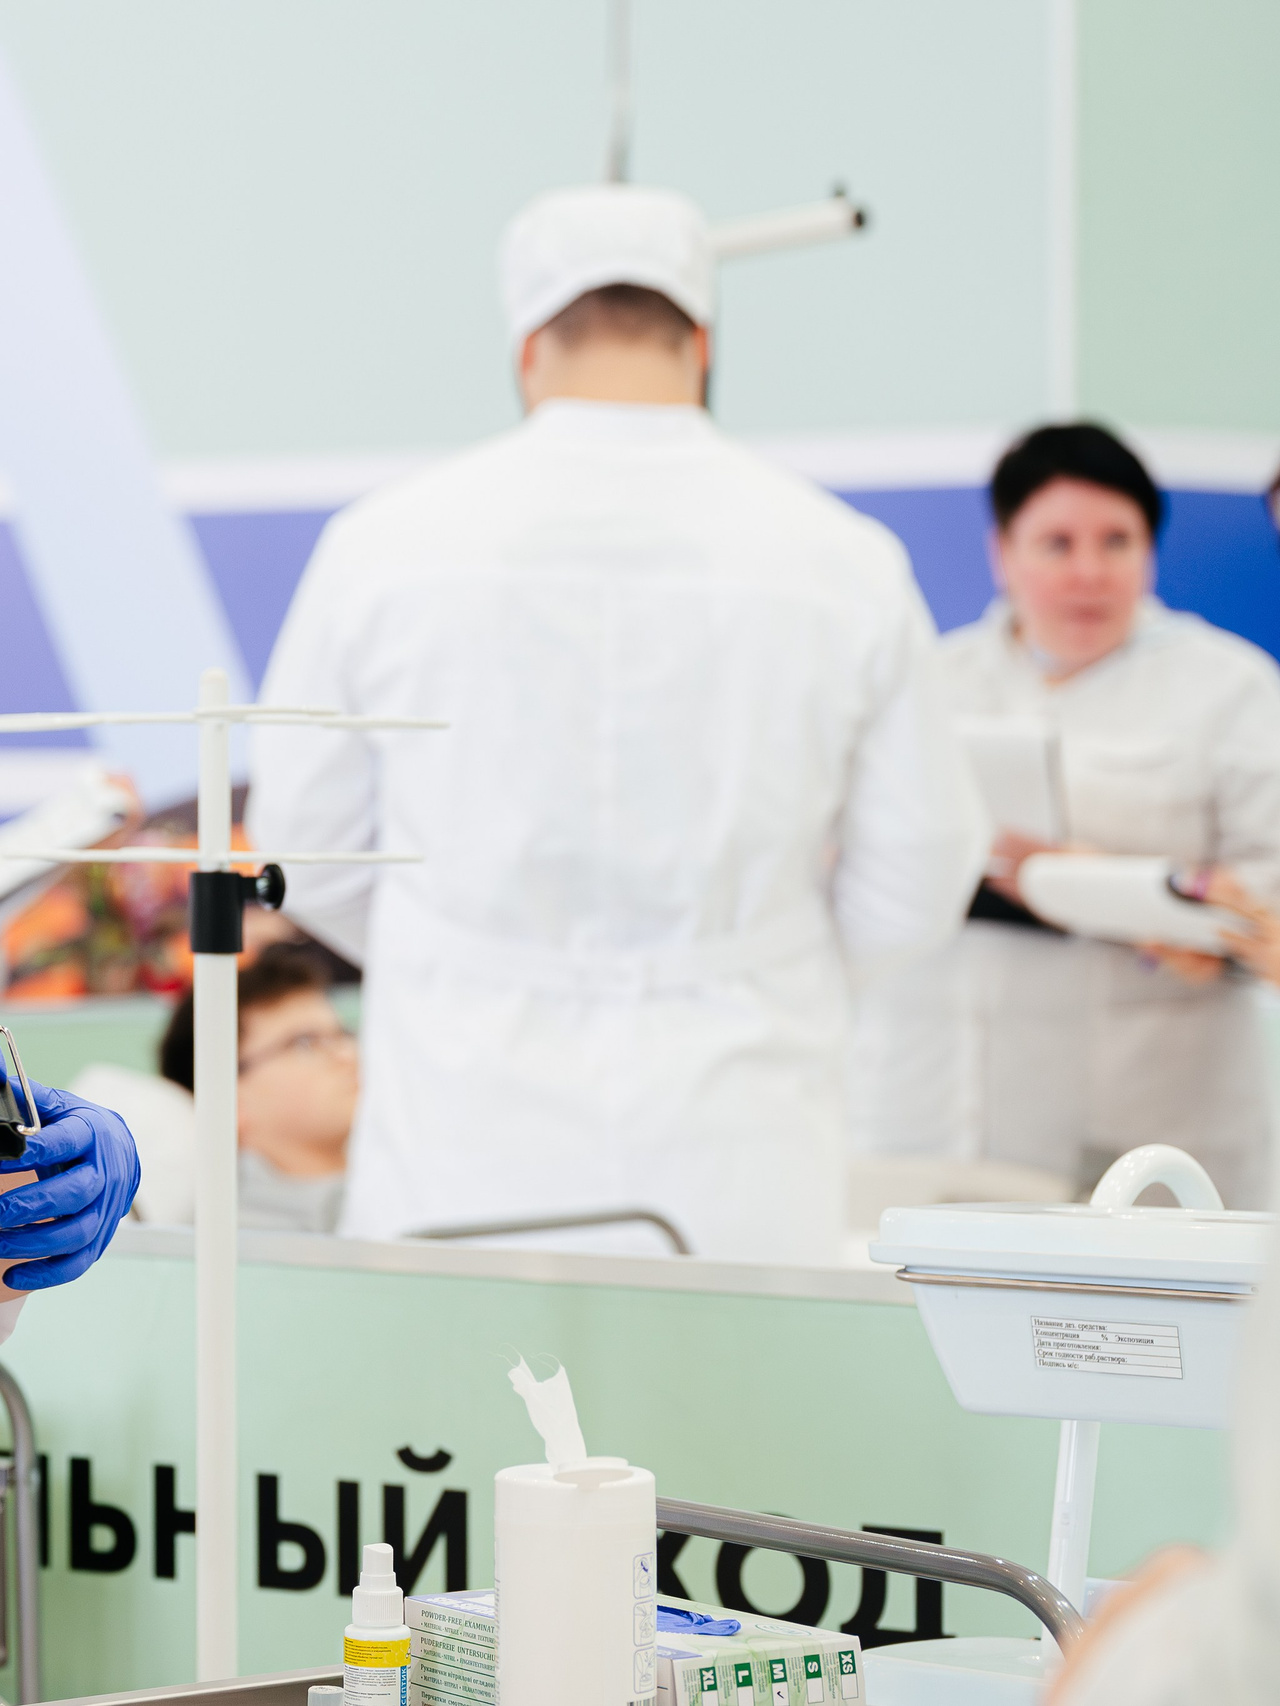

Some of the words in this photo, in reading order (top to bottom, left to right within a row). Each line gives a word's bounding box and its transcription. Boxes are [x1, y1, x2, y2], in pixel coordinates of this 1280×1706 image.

[1034, 1318, 1064, 1328] Название
[1064, 1321, 1077, 1329] дез.
[1078, 1323, 1108, 1331] средства:
[1035, 1328, 1080, 1339] Концентрация
[1101, 1333, 1108, 1341] %
[1115, 1334, 1154, 1344] Экспозиция
[1036, 1338, 1051, 1347] Дата
[1053, 1341, 1101, 1351] приготовления:
[1037, 1348, 1053, 1358] Срок
[1055, 1351, 1083, 1359] годности
[1038, 1359, 1066, 1368] Подпись
[421, 1610, 462, 1626] POWDER-FREE
[464, 1620, 495, 1634] EXAMINAT
[420, 1637, 455, 1652] PUDERFREIE
[808, 1661, 819, 1673] S
[840, 1653, 854, 1674] XS
[738, 1670, 749, 1683] L
[772, 1663, 785, 1680] M
[702, 1669, 715, 1691] XL
[421, 1691, 447, 1703] Перчатки
